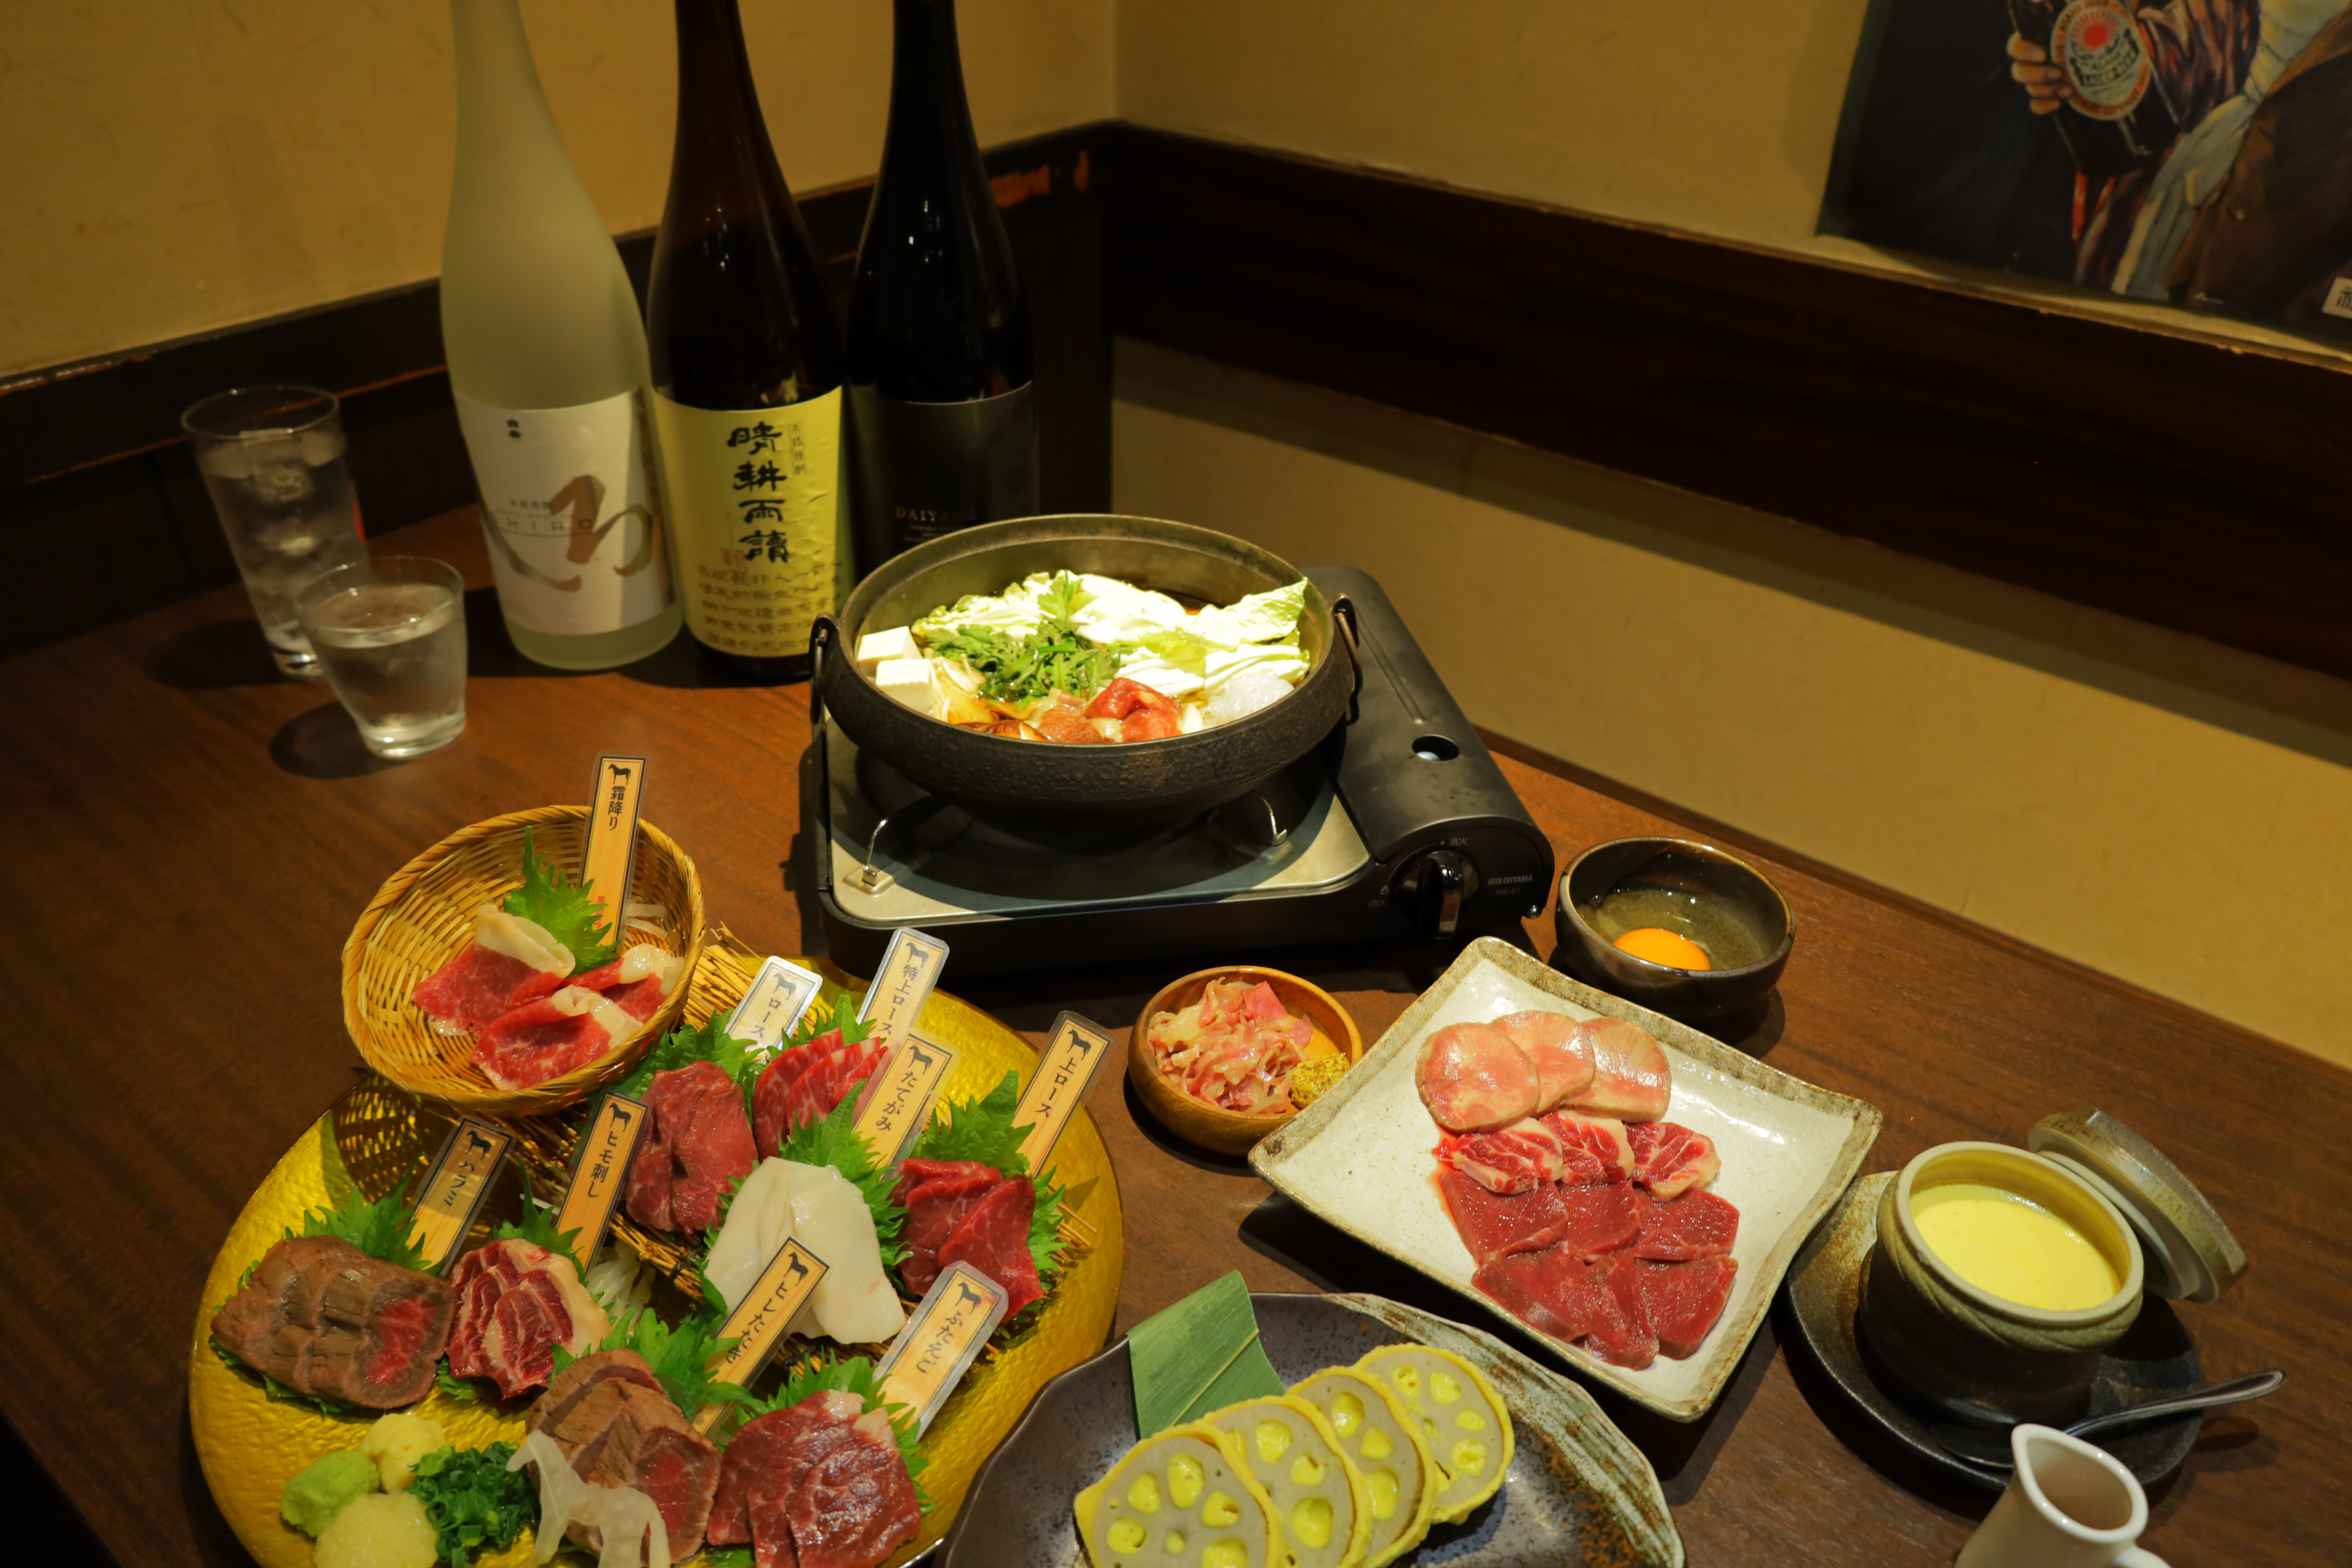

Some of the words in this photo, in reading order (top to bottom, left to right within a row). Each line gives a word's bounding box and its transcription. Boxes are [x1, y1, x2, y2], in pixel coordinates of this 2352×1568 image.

[492, 514, 593, 531] HIRO
[608, 786, 626, 831] 霜降り
[1449, 836, 1468, 847] 消火
[1367, 898, 1388, 908] 点火
[1488, 876, 1502, 886] IRIS
[1503, 874, 1533, 884] OHYAMA
[749, 997, 782, 1038] ロース
[875, 963, 920, 1035] 特上ロース
[875, 1071, 919, 1132] たてがみ
[1035, 1057, 1076, 1118] 上ロース
[444, 1161, 475, 1207] ハラミ
[587, 1131, 618, 1198] ヒモ刺し
[726, 1281, 788, 1365] ヒレたたき
[916, 1312, 964, 1374] ふたえご
